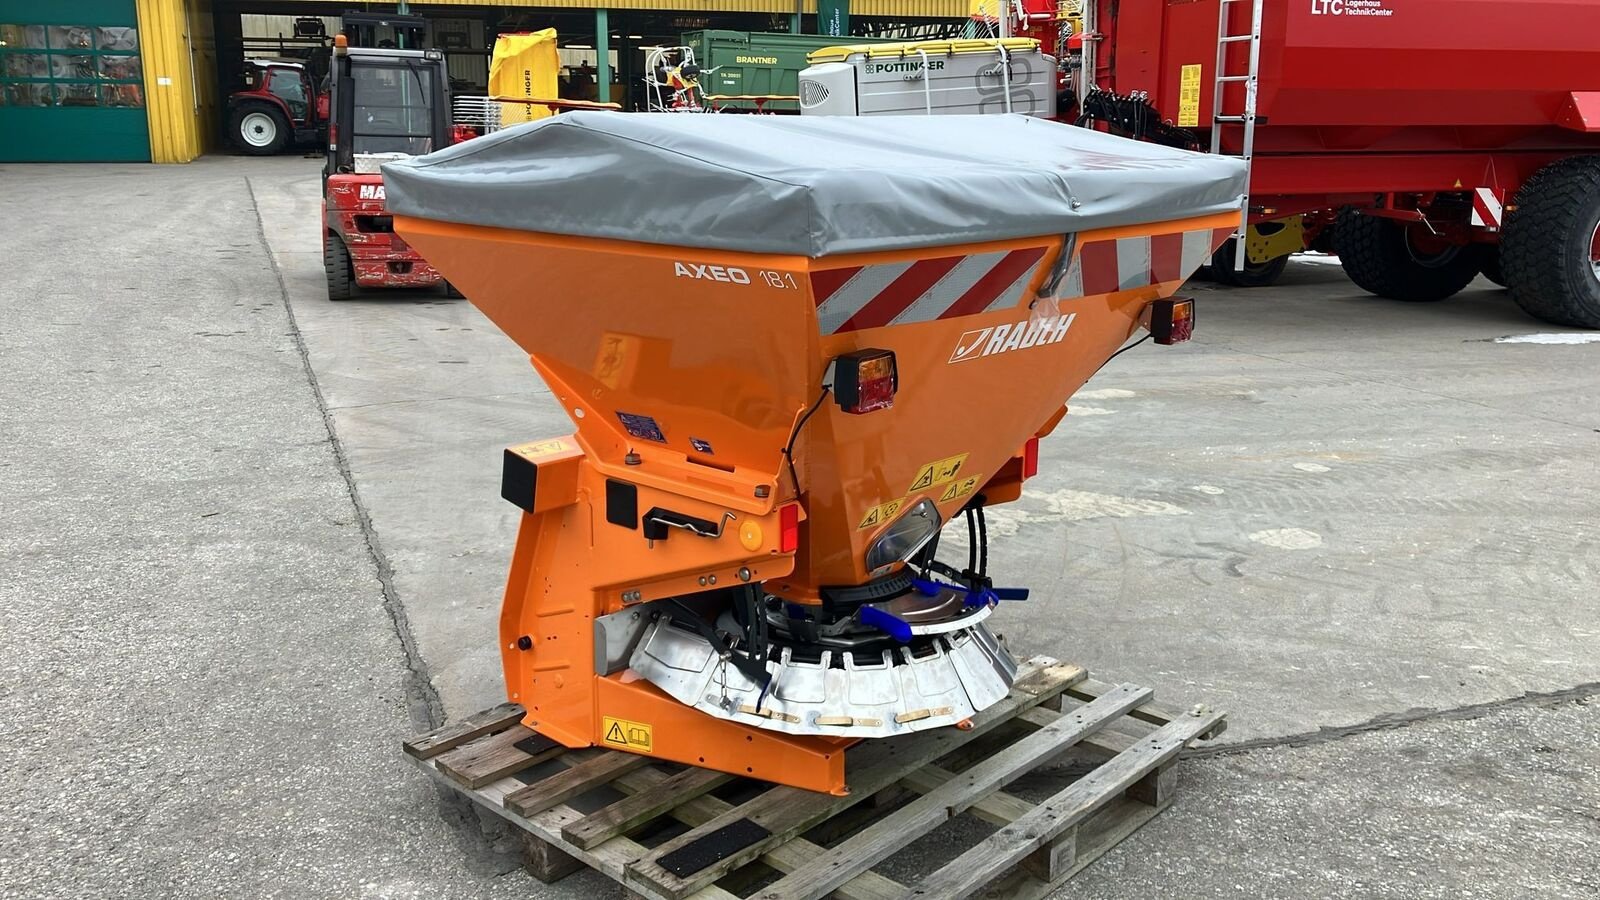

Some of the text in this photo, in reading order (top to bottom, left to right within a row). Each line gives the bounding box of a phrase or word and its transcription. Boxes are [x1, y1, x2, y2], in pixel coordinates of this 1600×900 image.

[1311, 0, 1343, 15] LTC
[1344, 7, 1393, 16] TechnikCenter
[736, 56, 778, 65] BRANTNER
[360, 185, 386, 200] MA
[674, 262, 798, 290] AXEO 18.1
